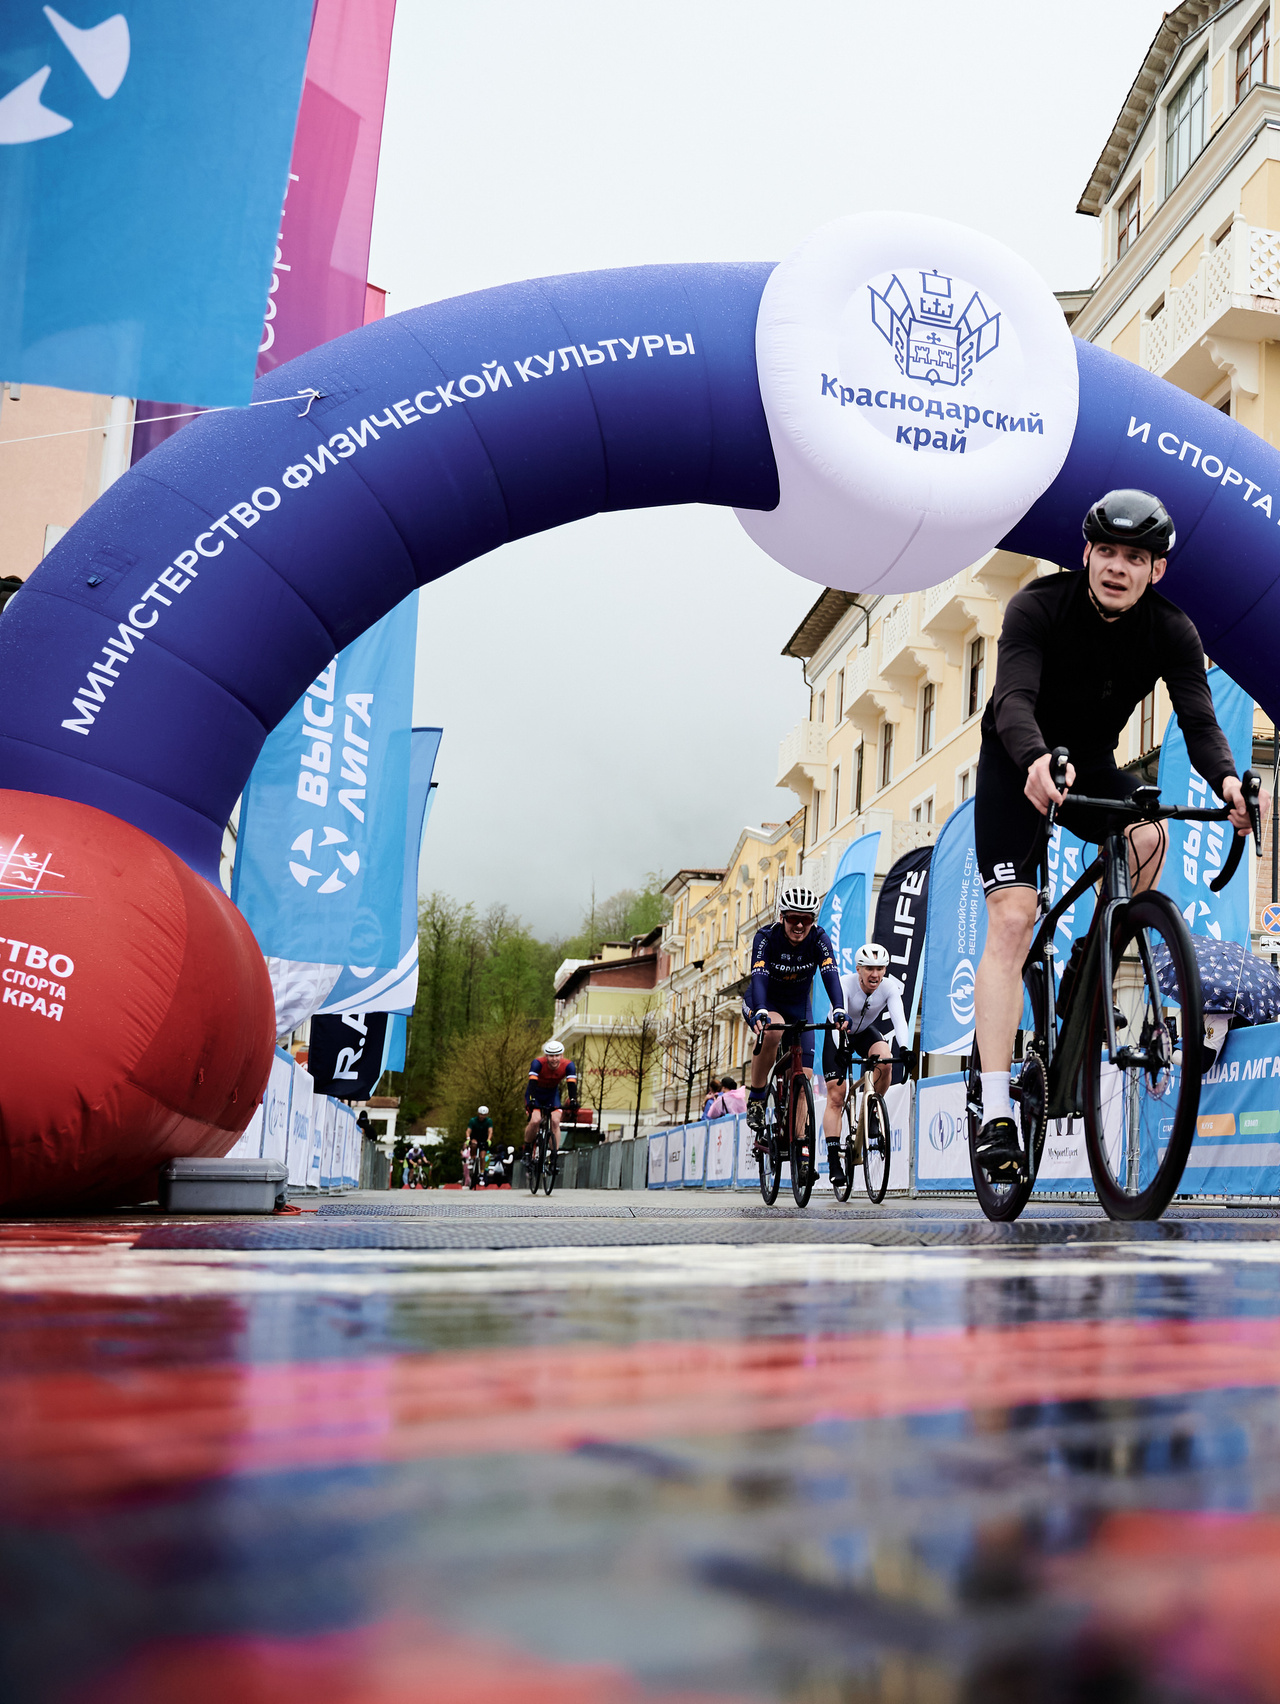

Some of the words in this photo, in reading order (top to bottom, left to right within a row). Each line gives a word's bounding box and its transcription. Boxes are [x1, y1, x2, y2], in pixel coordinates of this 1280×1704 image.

[821, 372, 1044, 435] Краснодарский
[1126, 416, 1150, 443] И
[896, 425, 967, 454] край
[61, 486, 282, 736] МИНИСТЕРСТВО
[281, 361, 513, 491] ФИЗИЧЕСКОЙ
[513, 333, 696, 383] КУЛЬТУРЫ
[297, 654, 339, 808] ВЫСШ
[337, 693, 374, 824] ЛИГА
[963, 847, 975, 877] СЕТИ
[957, 878, 970, 954] РОССИЙСКИЕ
[969, 900, 979, 955] ВЕЩАНИЯ
[2, 968, 66, 1001] СПОРТА
[2, 987, 64, 1022] КРАЯ
